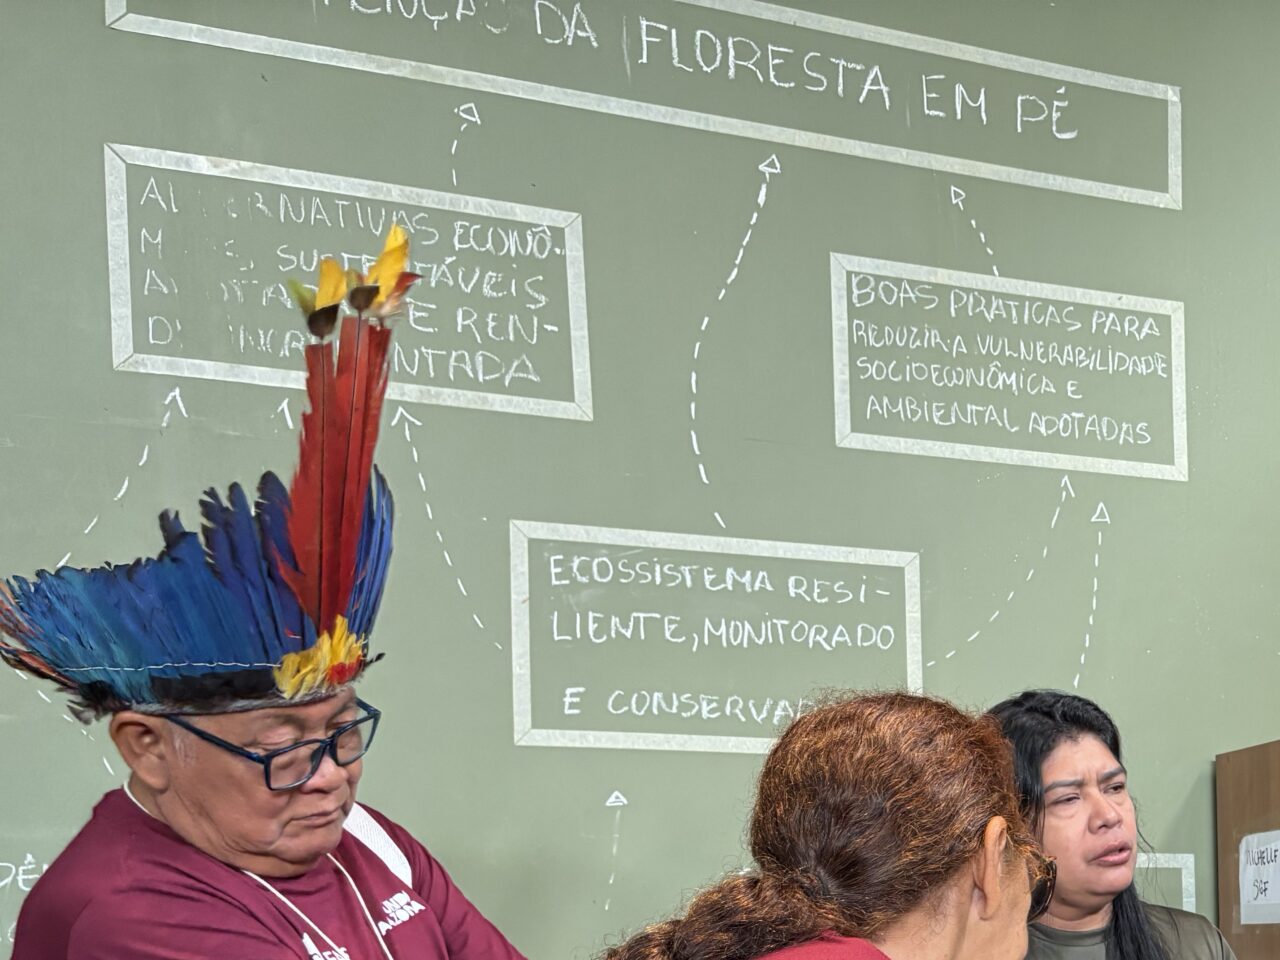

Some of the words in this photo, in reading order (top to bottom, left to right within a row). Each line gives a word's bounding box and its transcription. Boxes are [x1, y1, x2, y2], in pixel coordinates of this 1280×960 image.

[534, 0, 598, 47] DA
[638, 16, 890, 109] FLORESTA
[922, 74, 987, 124] EM
[1016, 86, 1078, 140] PÉ
[851, 272, 939, 311] BOAS
[1091, 310, 1161, 341] PARA
[1067, 380, 1084, 399] E
[866, 394, 1020, 432] AMBIENTAL
[1028, 411, 1152, 445] ADOTADAS
[550, 555, 775, 593] ECOSSISTEMA
[564, 686, 587, 716] E
